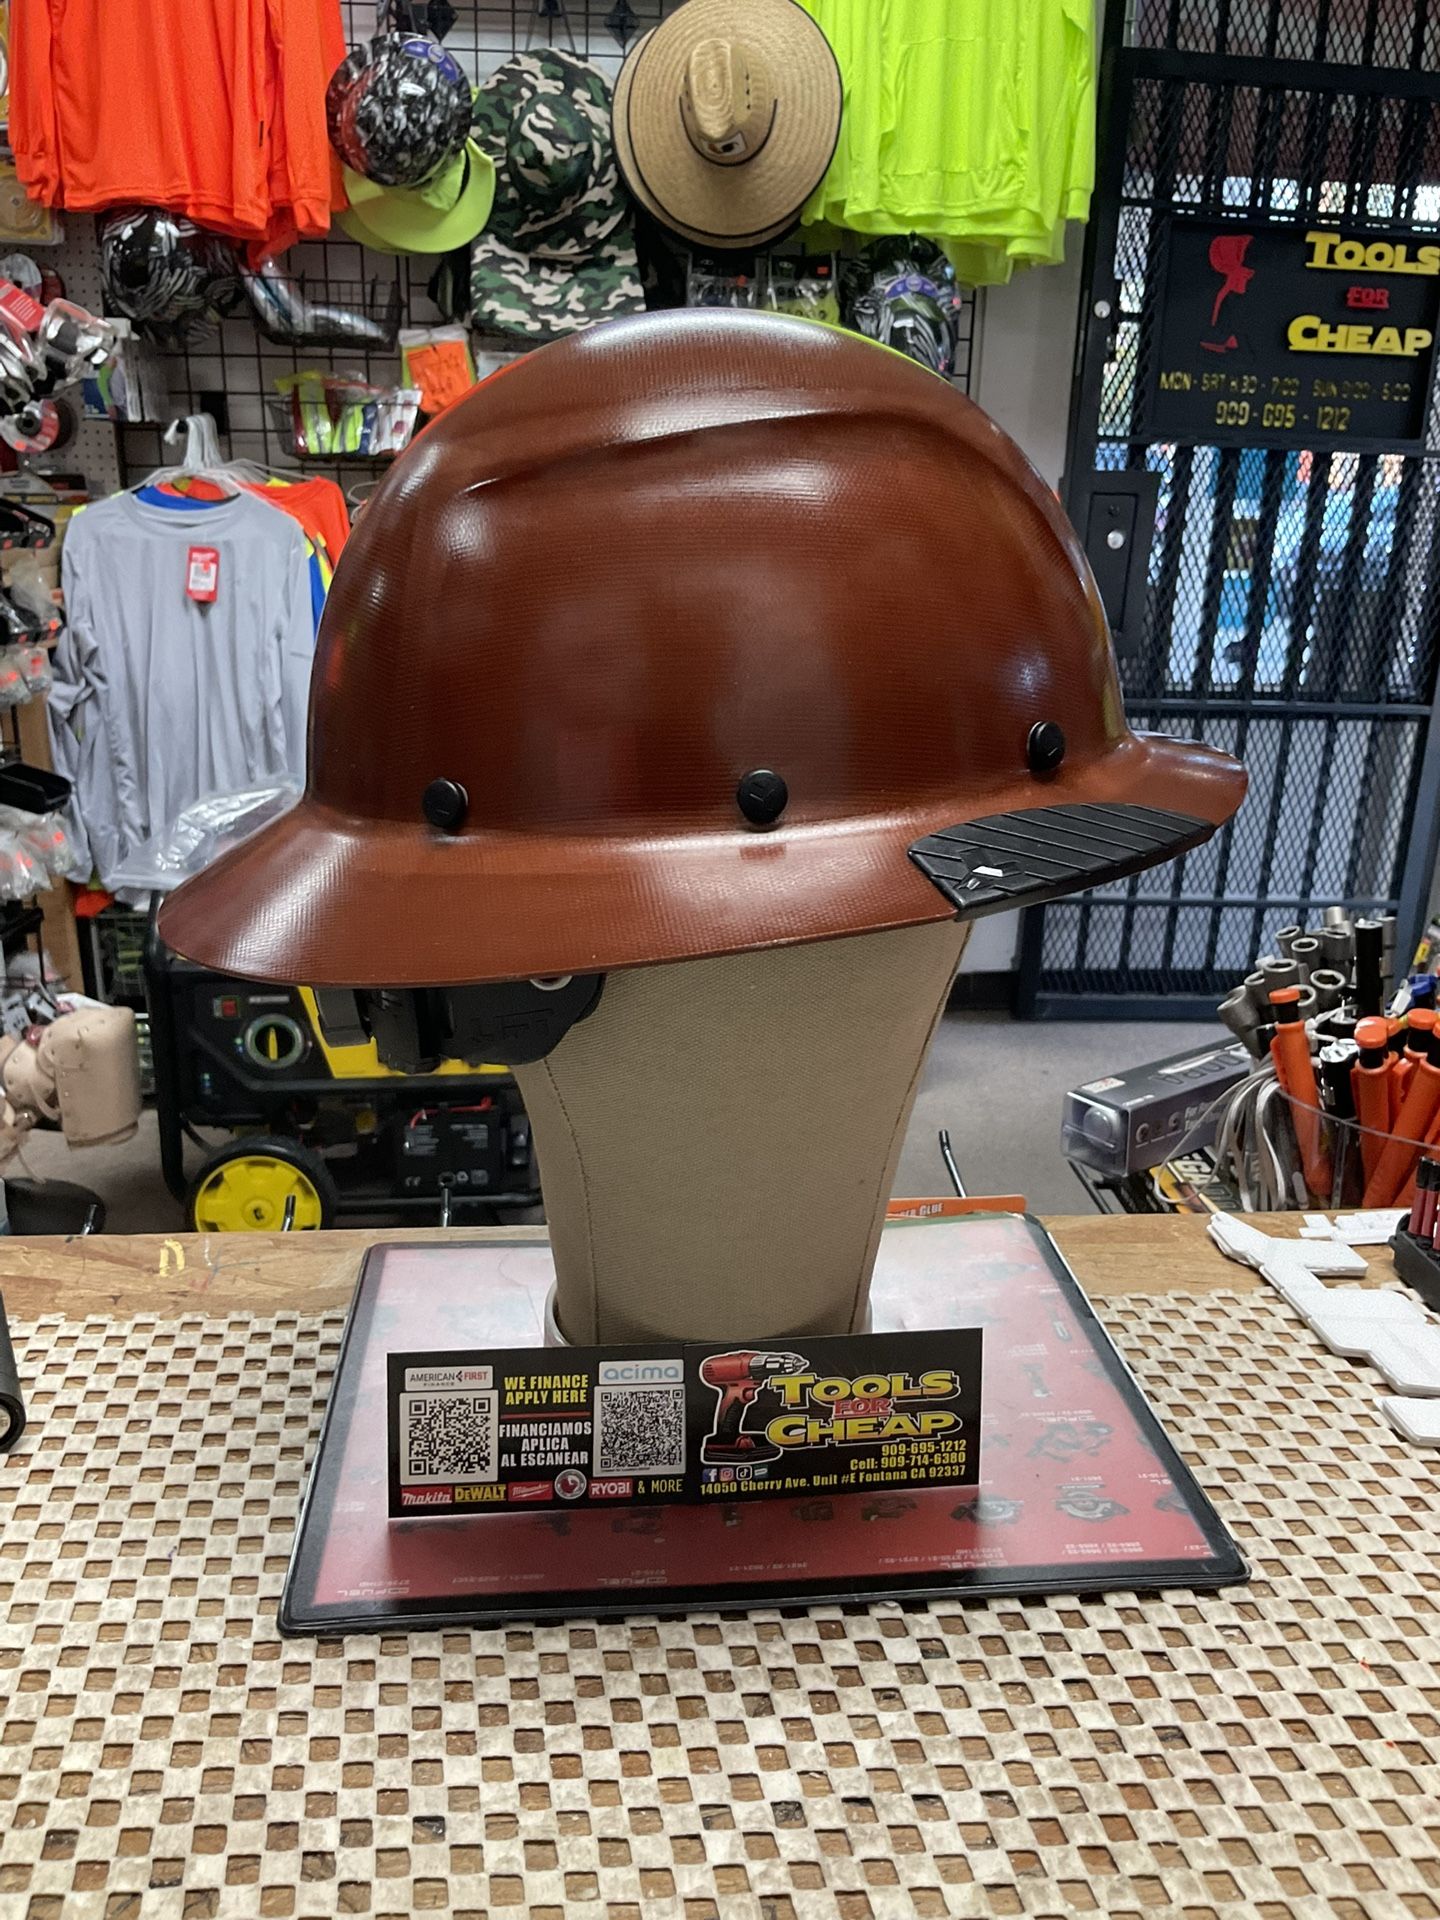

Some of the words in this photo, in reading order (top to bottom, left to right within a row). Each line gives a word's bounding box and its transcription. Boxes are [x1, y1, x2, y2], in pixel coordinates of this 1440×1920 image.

[1305, 231, 1440, 275] TOOLS
[1347, 286, 1389, 309] FOR
[1288, 314, 1432, 356] CHEAP
[409, 1373, 455, 1382] AMERICAN
[463, 1371, 488, 1381] FIRST
[603, 1364, 680, 1380] acima
[504, 1376, 527, 1390] WE
[530, 1374, 589, 1389] FINANCE
[769, 1372, 961, 1409] TOOLS
[505, 1390, 549, 1405] APPLY
[552, 1388, 587, 1404] HERE
[834, 1397, 894, 1419] FOR
[500, 1421, 592, 1438] FINANCIAMOS
[766, 1411, 963, 1447] CHEAP
[521, 1436, 570, 1451] APLICA
[881, 1440, 967, 1456] 909-695-1212
[501, 1453, 517, 1468] AL
[520, 1451, 589, 1467] ESCANEAR
[850, 1458, 879, 1471] Cell:
[880, 1452, 966, 1468] 909-714-6380
[591, 1482, 630, 1495] RYOBI
[638, 1481, 645, 1494] &
[651, 1479, 684, 1493] MORE
[700, 1481, 737, 1495] 14050
[740, 1479, 782, 1492] Cherry
[784, 1477, 811, 1488] Ave.
[812, 1474, 838, 1486] Unit
[841, 1473, 856, 1485] #E
[859, 1470, 907, 1484] Fontana
[910, 1467, 926, 1479] CA
[928, 1465, 966, 1478] 92337
